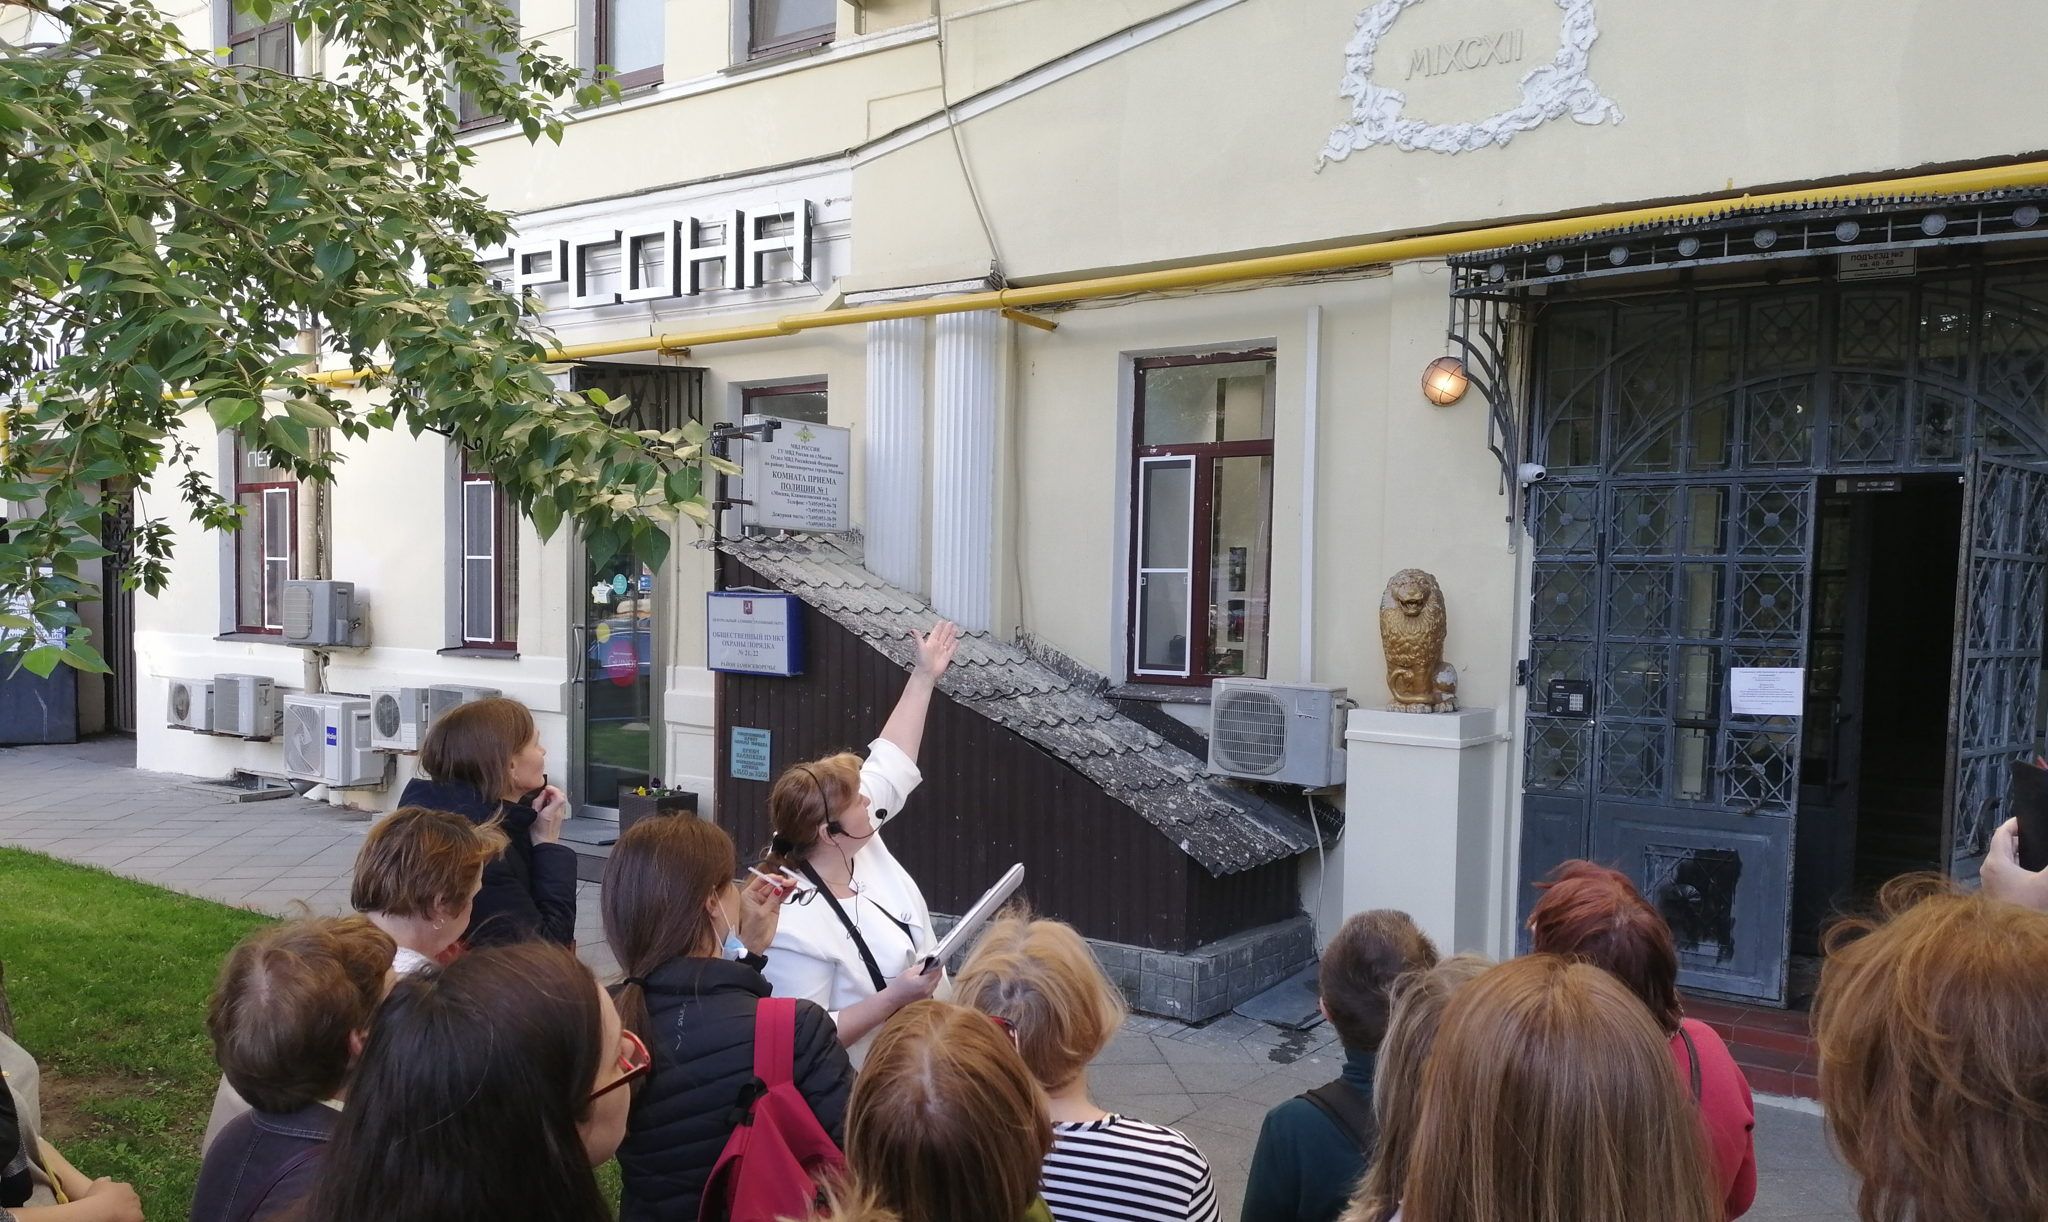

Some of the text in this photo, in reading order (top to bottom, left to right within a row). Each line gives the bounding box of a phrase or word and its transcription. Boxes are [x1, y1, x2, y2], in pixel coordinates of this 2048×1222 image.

[1405, 28, 1524, 80] MIXCXII
[466, 198, 815, 317] РСОНА
[772, 471, 837, 486] КОМНАТА ПРИЕМА
[780, 481, 816, 493] ПОЛИЦИИ
[817, 486, 824, 494] №
[712, 631, 785, 642] ОБЩЕСТВЕННЫЙ ПУНКТ
[721, 640, 775, 650] ОХРАНЫ ПОРЯДКА
